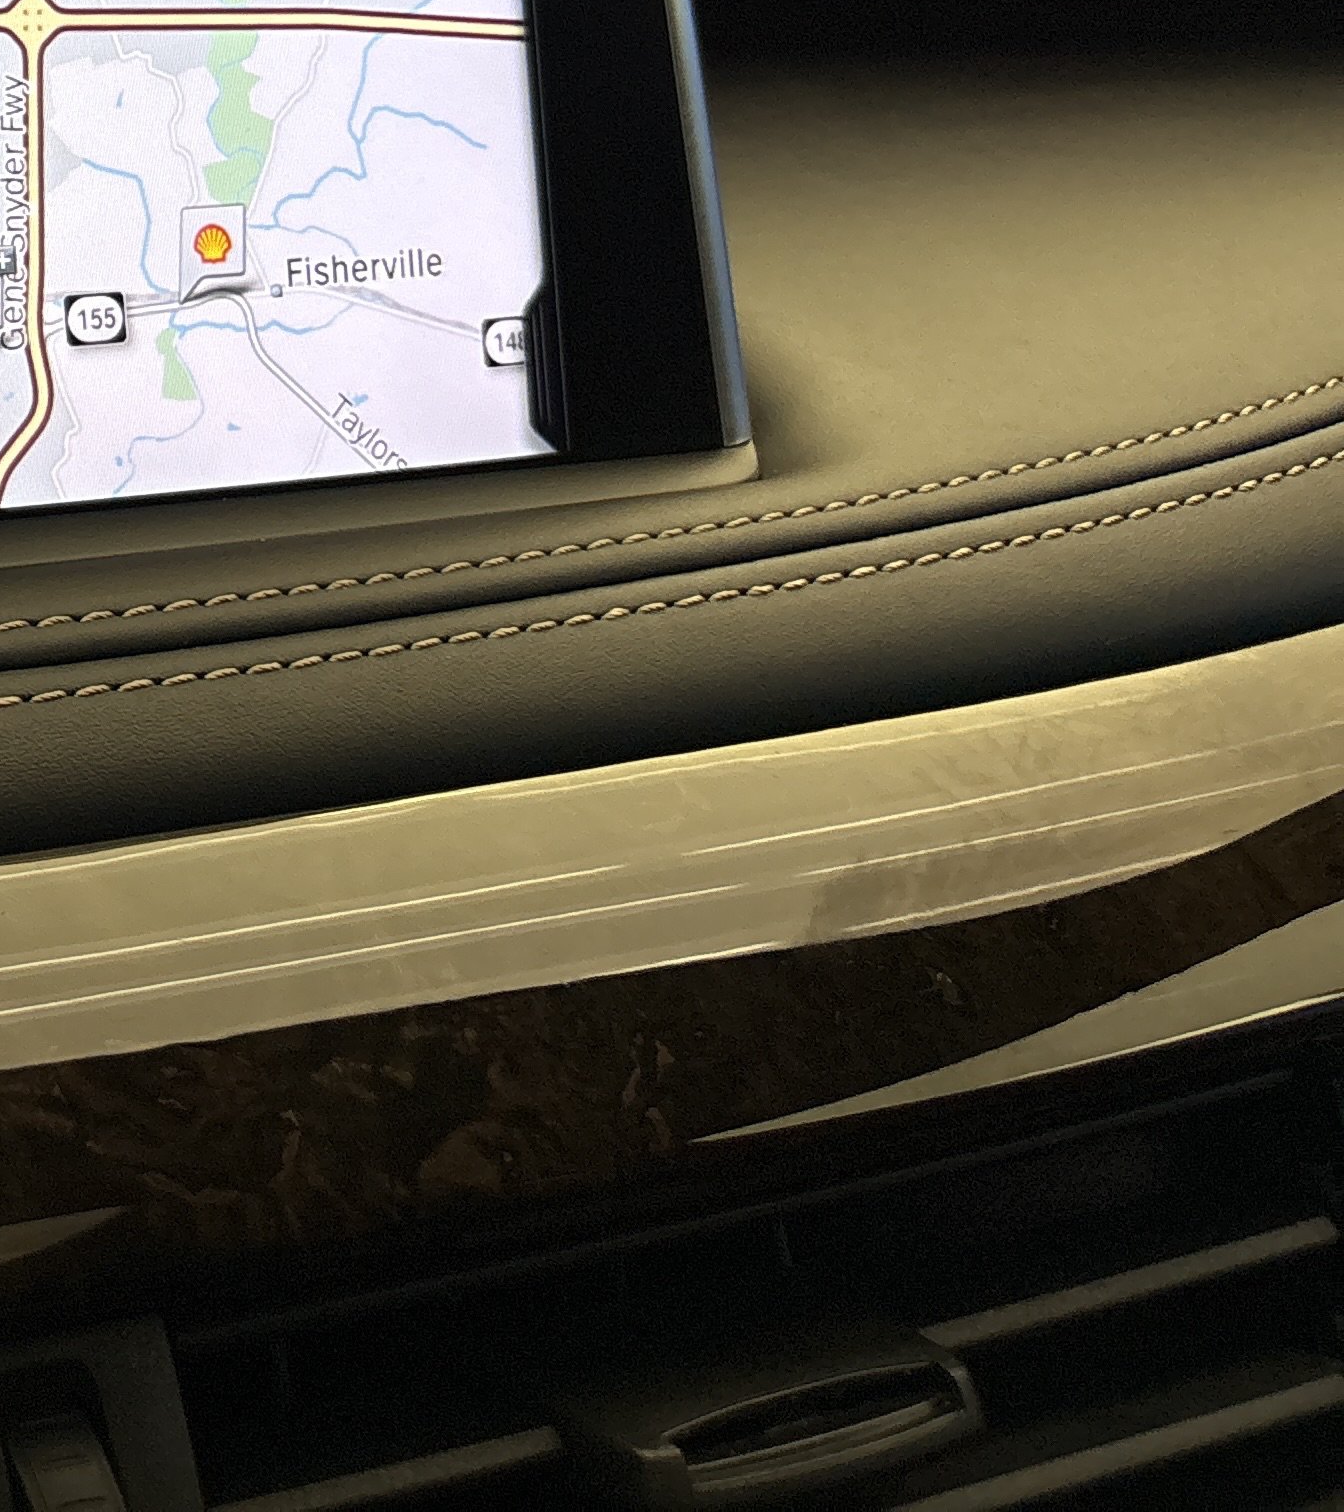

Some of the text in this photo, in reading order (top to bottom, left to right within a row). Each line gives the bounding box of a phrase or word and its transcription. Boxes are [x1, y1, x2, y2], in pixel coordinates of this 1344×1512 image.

[1, 75, 29, 131] Fwy
[287, 248, 442, 287] Fisherville
[77, 307, 118, 333] 155
